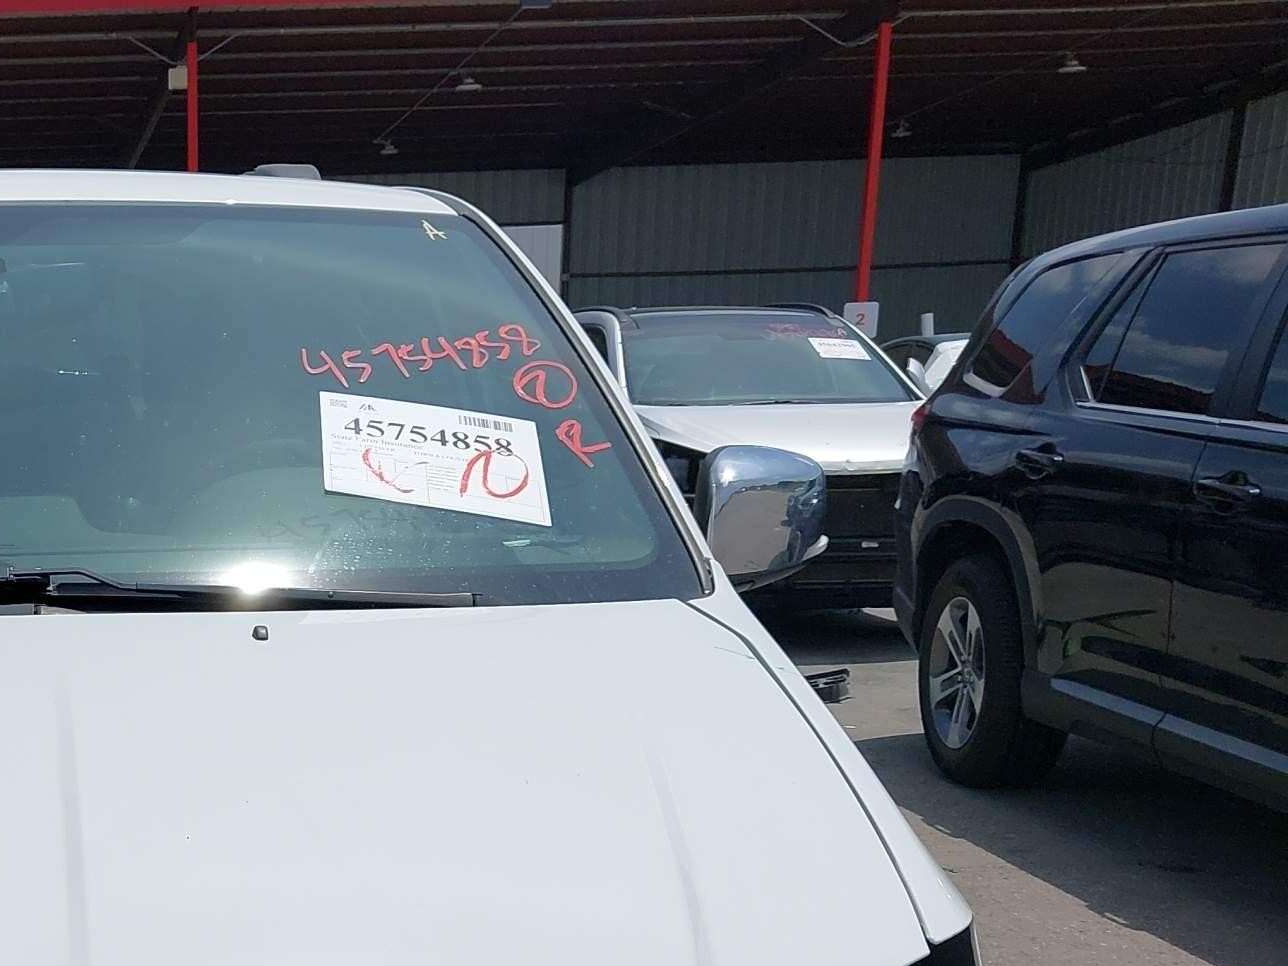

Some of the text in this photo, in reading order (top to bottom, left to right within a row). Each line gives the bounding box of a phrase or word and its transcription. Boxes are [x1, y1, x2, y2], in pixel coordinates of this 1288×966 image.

[855, 312, 865, 326] 2
[302, 324, 541, 388] 45754858
[344, 417, 514, 457] 45754858
